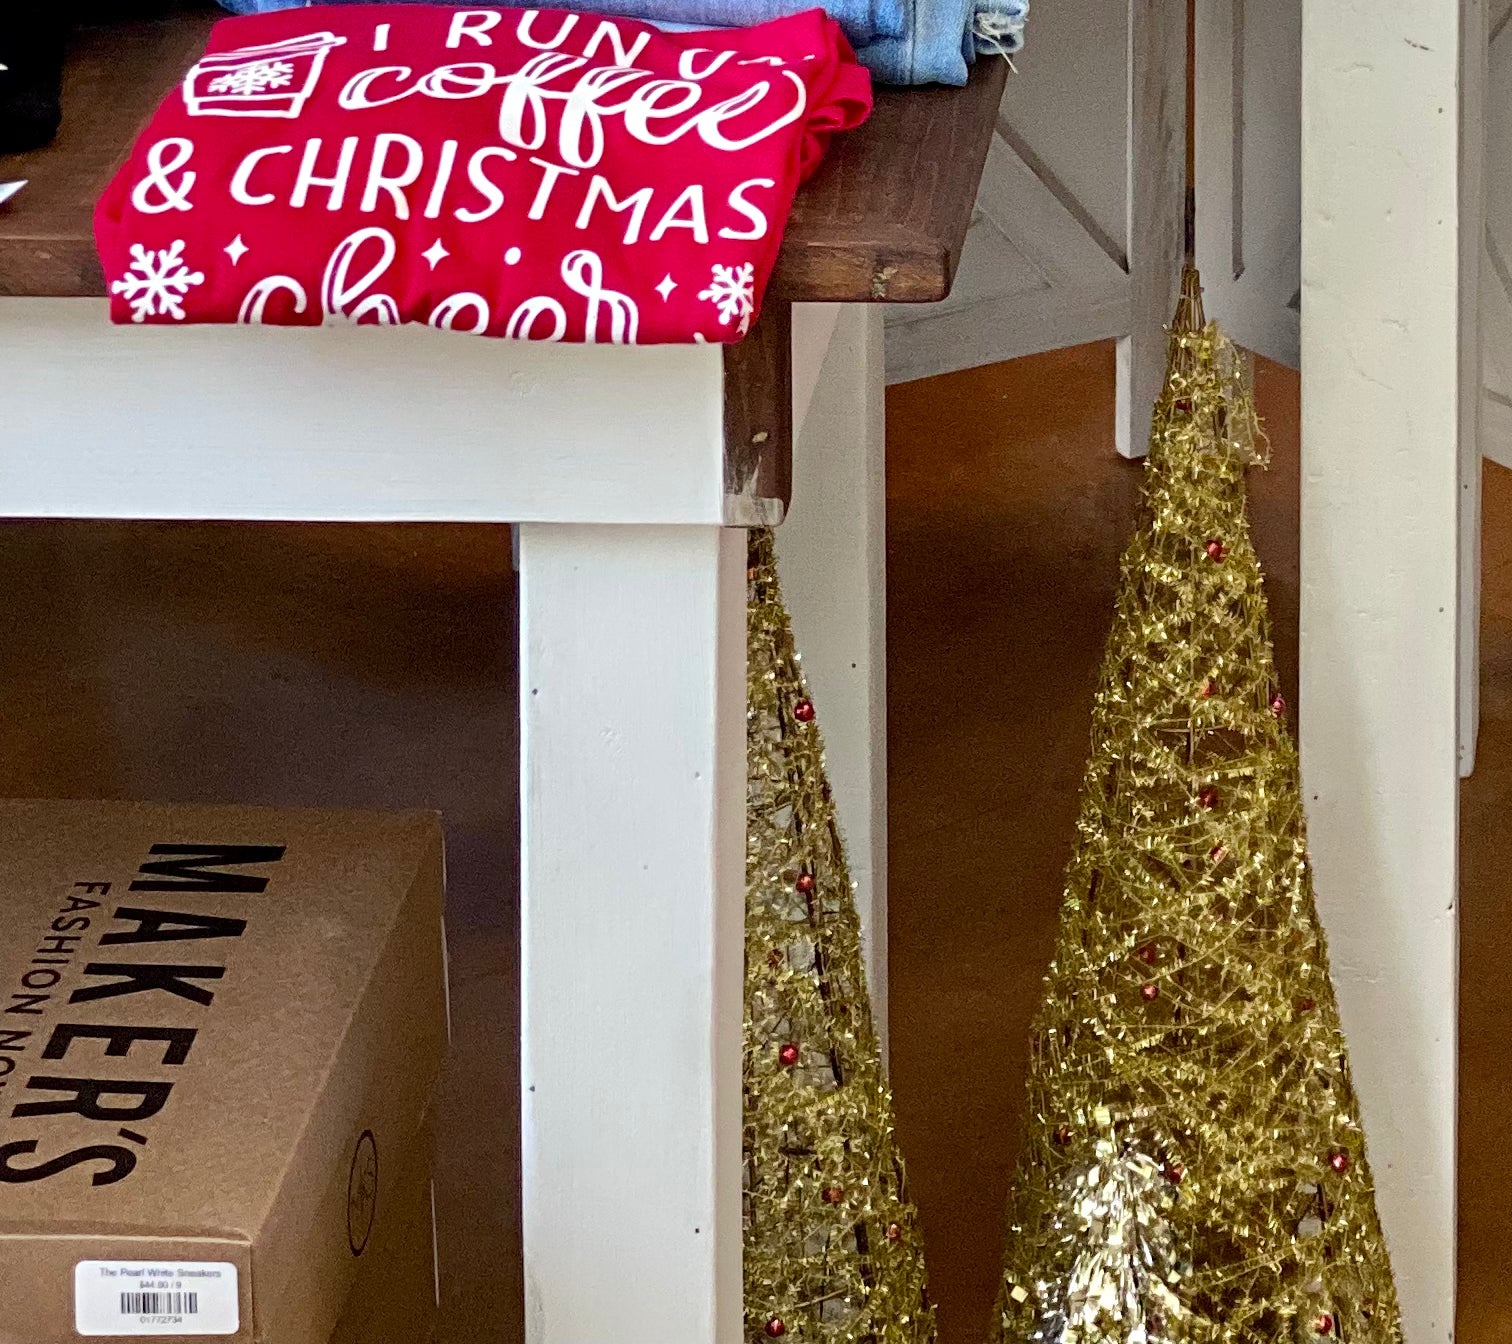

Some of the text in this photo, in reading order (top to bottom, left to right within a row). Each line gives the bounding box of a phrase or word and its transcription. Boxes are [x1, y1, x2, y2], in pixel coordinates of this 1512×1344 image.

[372, 23, 391, 53] I
[447, 9, 647, 69] RUN
[338, 51, 808, 169] coffee
[130, 132, 775, 246] & CHRISTMAS
[4, 881, 112, 1015] FASHION
[0, 843, 287, 1188] MAKER'S
[100, 1267, 117, 1278] The
[148, 1268, 174, 1278] White
[177, 1268, 222, 1279] Sneakers
